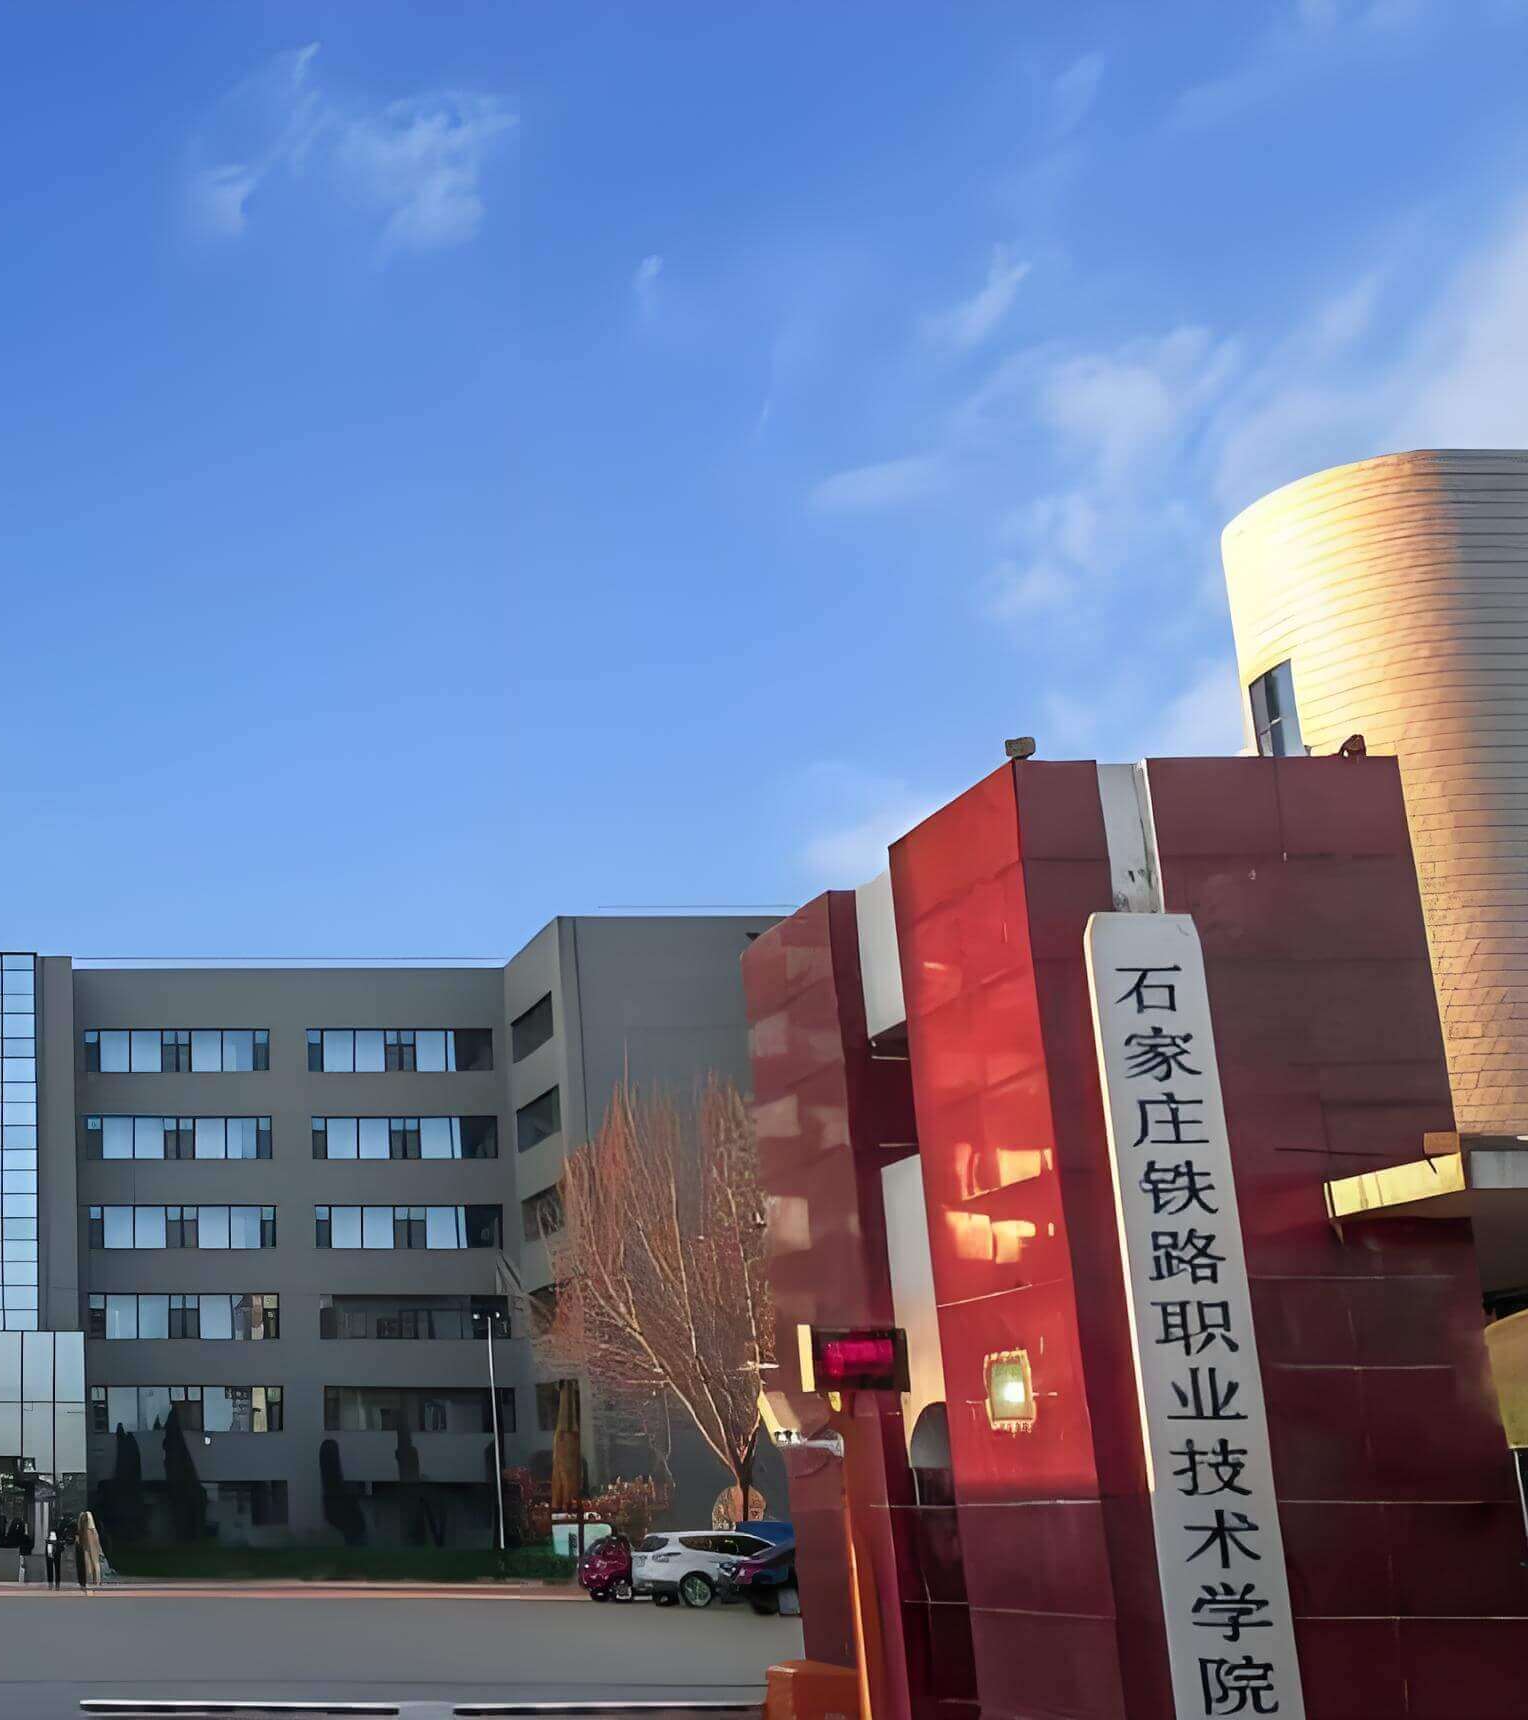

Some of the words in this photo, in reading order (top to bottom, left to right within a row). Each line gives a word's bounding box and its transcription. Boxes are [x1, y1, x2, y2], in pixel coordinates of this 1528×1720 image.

[1115, 964, 1280, 1717] 石家庄铁路职业技术学院
